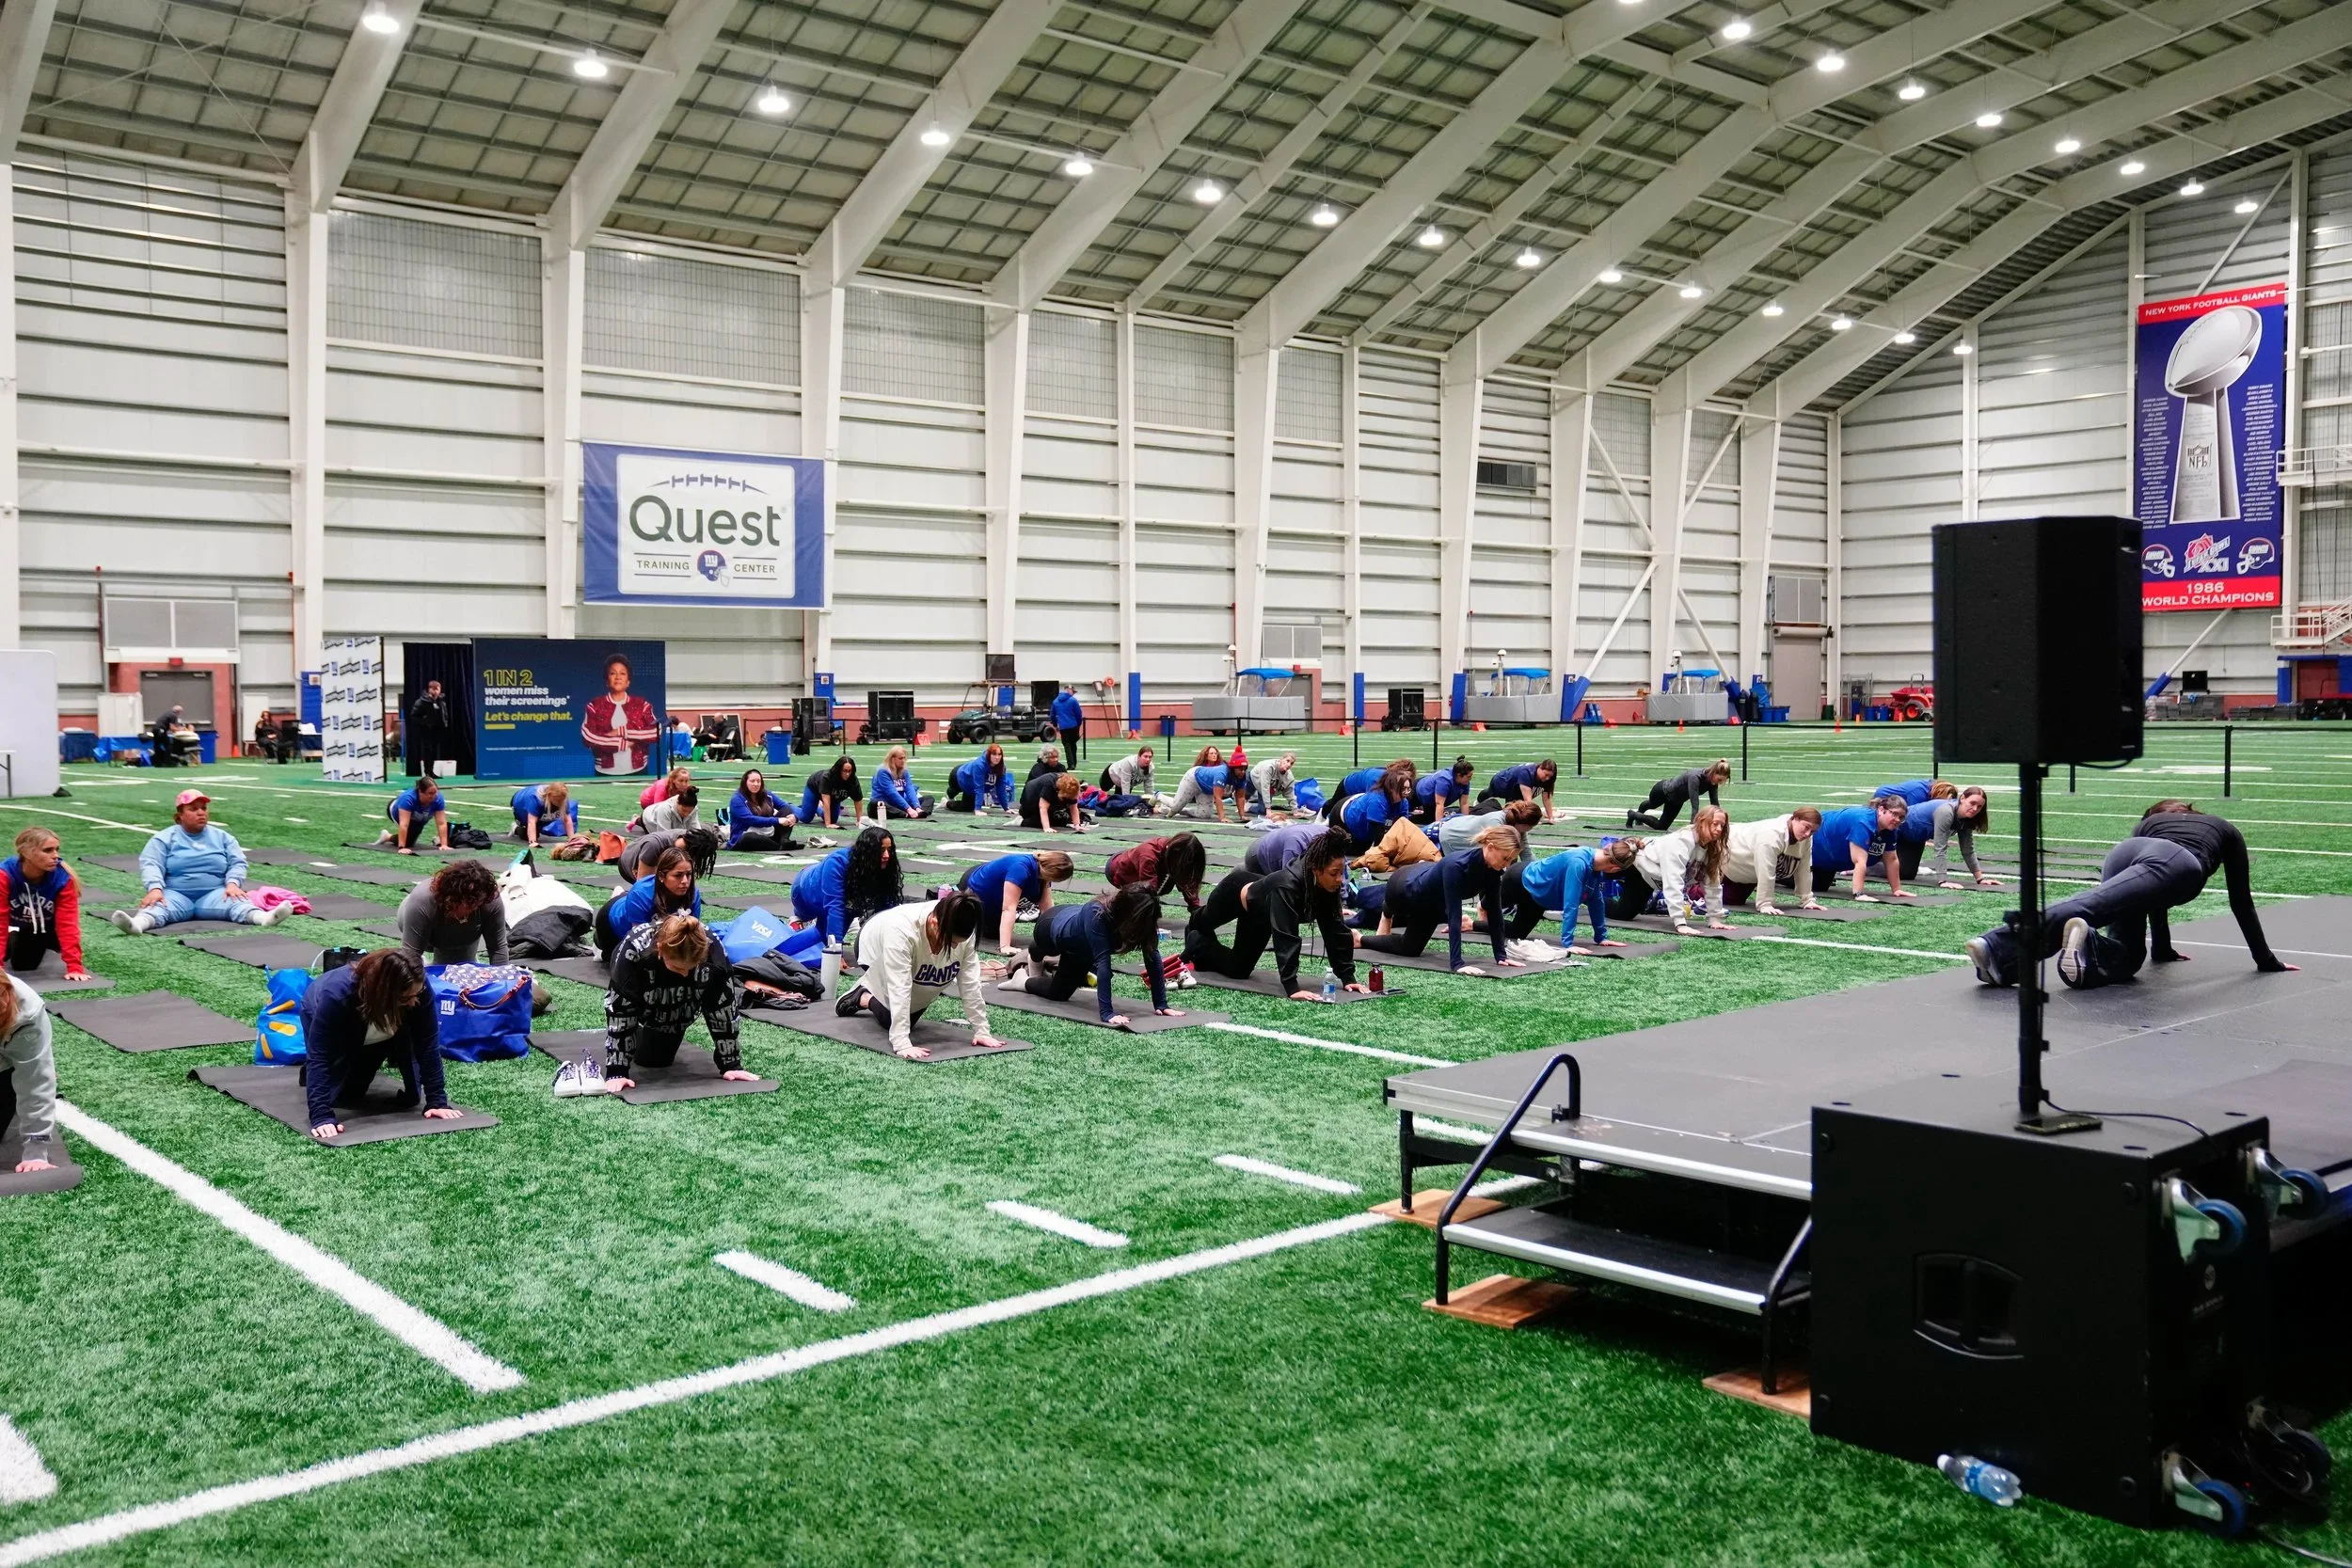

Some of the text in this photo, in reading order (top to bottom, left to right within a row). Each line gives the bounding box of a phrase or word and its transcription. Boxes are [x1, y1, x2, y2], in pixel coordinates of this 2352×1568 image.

[2145, 290, 2277, 316] NEW YORK FOOTBALL GIANTS
[629, 495, 782, 546] Quest
[637, 560, 775, 574] TRAINING CENTER
[2198, 557, 2230, 573] XXI
[2186, 582, 2225, 594] 1986
[2142, 592, 2275, 607] WORLD CHAMPIONS
[484, 669, 533, 687] 1 IN 2
[485, 685, 549, 696] women miss
[485, 695, 510, 706] their
[511, 711, 549, 722] change
[549, 711, 573, 721] that.
[751, 920, 773, 938] VISA
[914, 960, 961, 983] GIANTS
